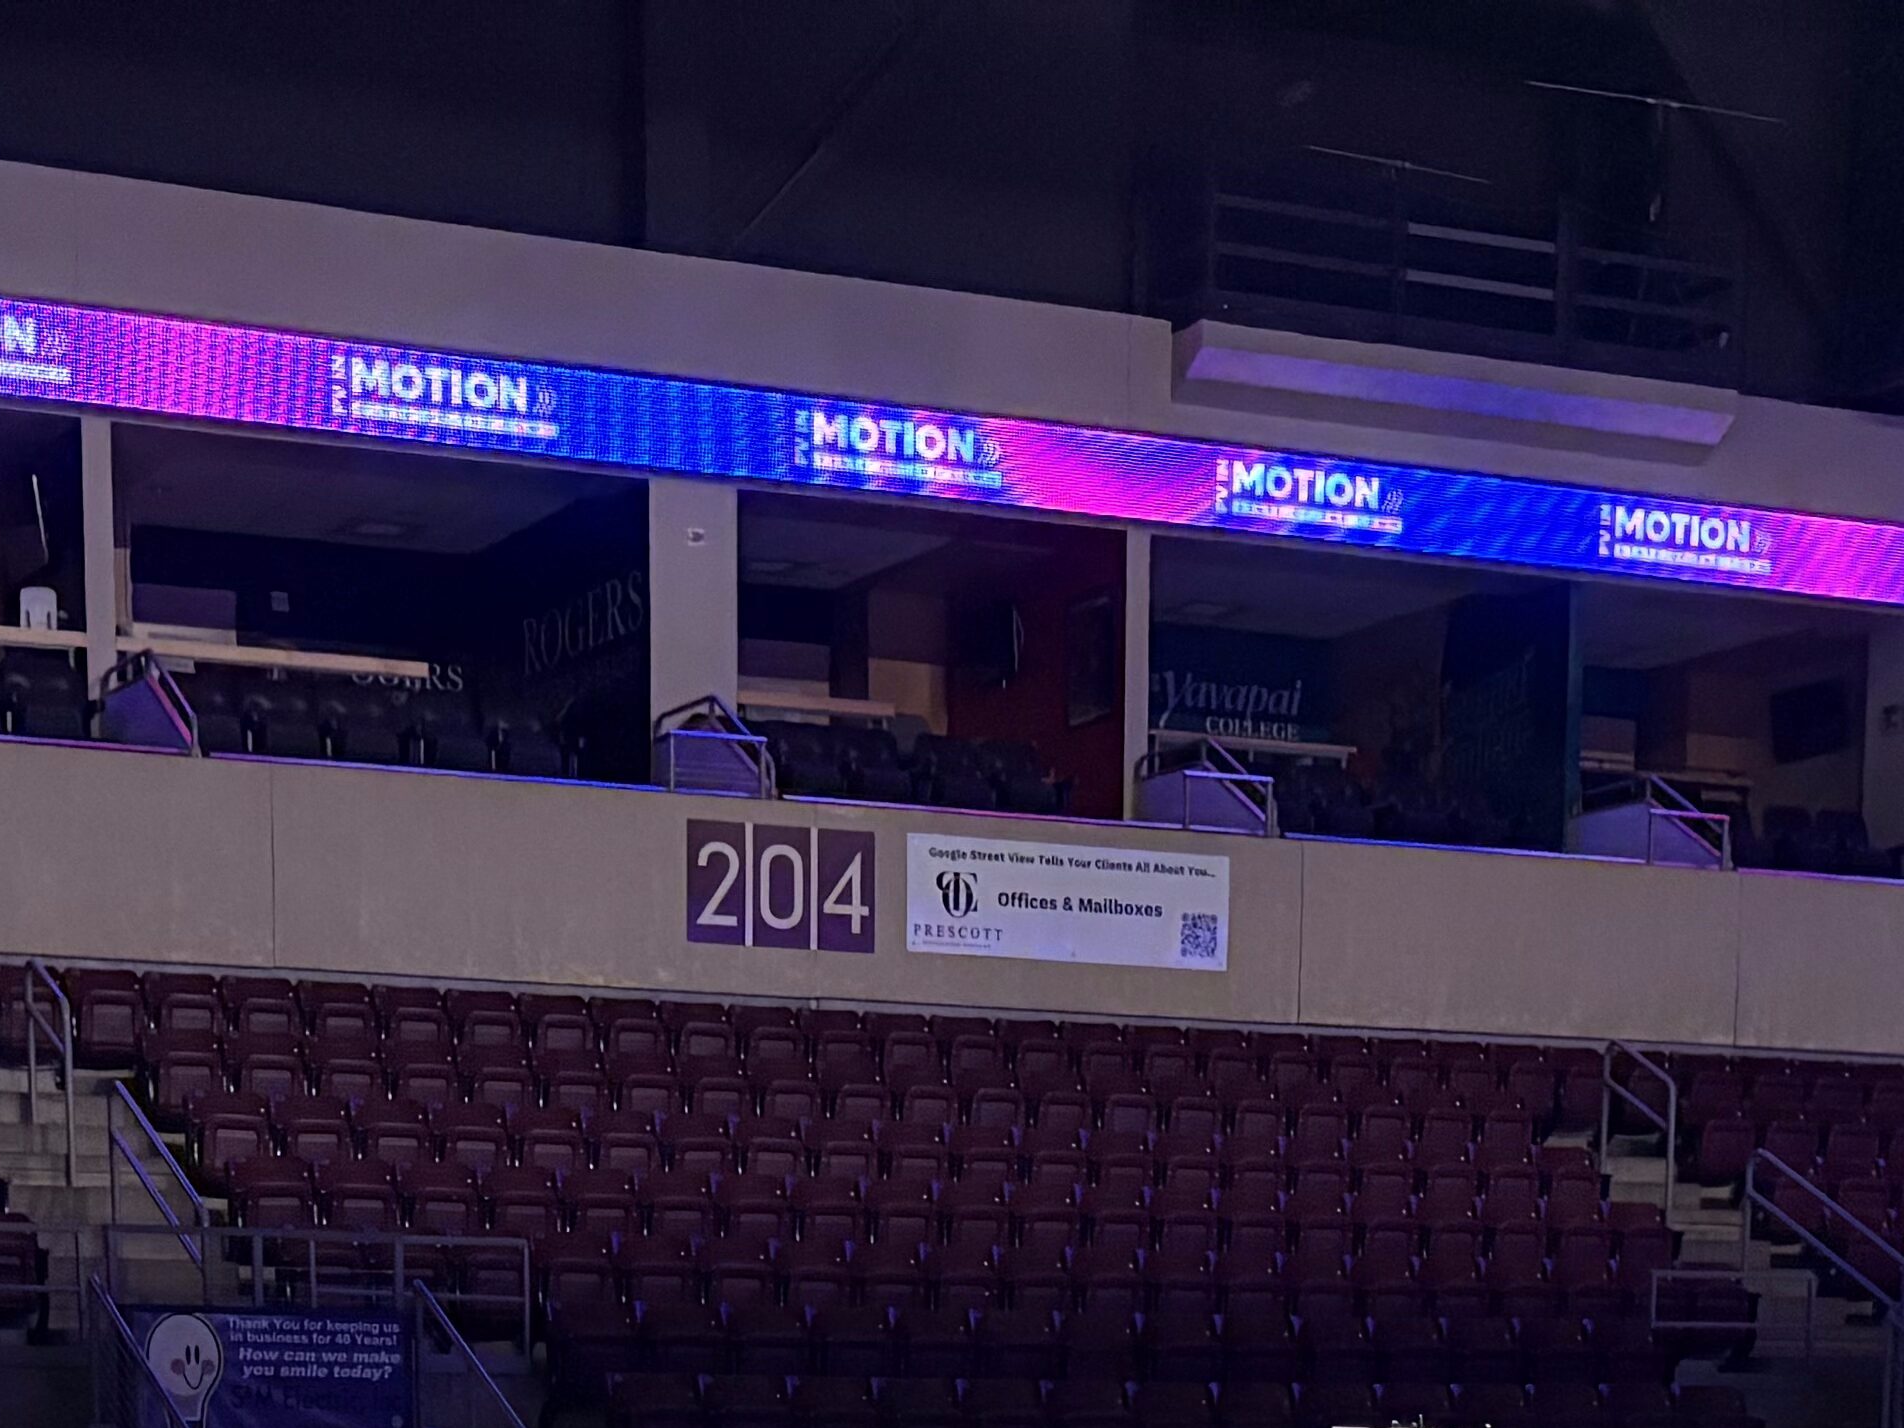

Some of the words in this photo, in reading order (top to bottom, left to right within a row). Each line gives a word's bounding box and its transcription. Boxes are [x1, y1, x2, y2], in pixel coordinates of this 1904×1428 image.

[351, 356, 529, 415] MOTION
[812, 410, 977, 463] MOTION
[1232, 459, 1381, 510] MOTION
[1614, 505, 1752, 553] MOTION
[1159, 669, 1304, 729] Yavapai
[928, 846, 968, 862] Google
[969, 849, 1006, 863] Street
[1007, 852, 1035, 865] View
[1038, 854, 1065, 868] Tells
[1067, 856, 1092, 870] Your
[1094, 858, 1134, 873] Clients
[1135, 861, 1151, 874] All
[1152, 863, 1186, 877] About
[695, 840, 870, 936] 204
[997, 890, 1058, 911] Offices
[1062, 895, 1074, 912] &
[1078, 896, 1164, 918] Mailboxes
[913, 923, 1003, 942] PRESCOTT
[228, 1318, 269, 1331] Thank
[272, 1319, 301, 1332] You
[303, 1318, 322, 1332] for
[326, 1319, 380, 1335] keeping
[382, 1322, 401, 1334] us
[246, 1331, 309, 1345] business
[312, 1332, 332, 1345] for
[238, 1346, 279, 1361] How
[283, 1351, 316, 1363] can
[321, 1351, 348, 1363] we
[353, 1350, 401, 1364] make
[242, 1364, 275, 1380] you
[279, 1364, 329, 1378] smile
[332, 1364, 393, 1382] today?
